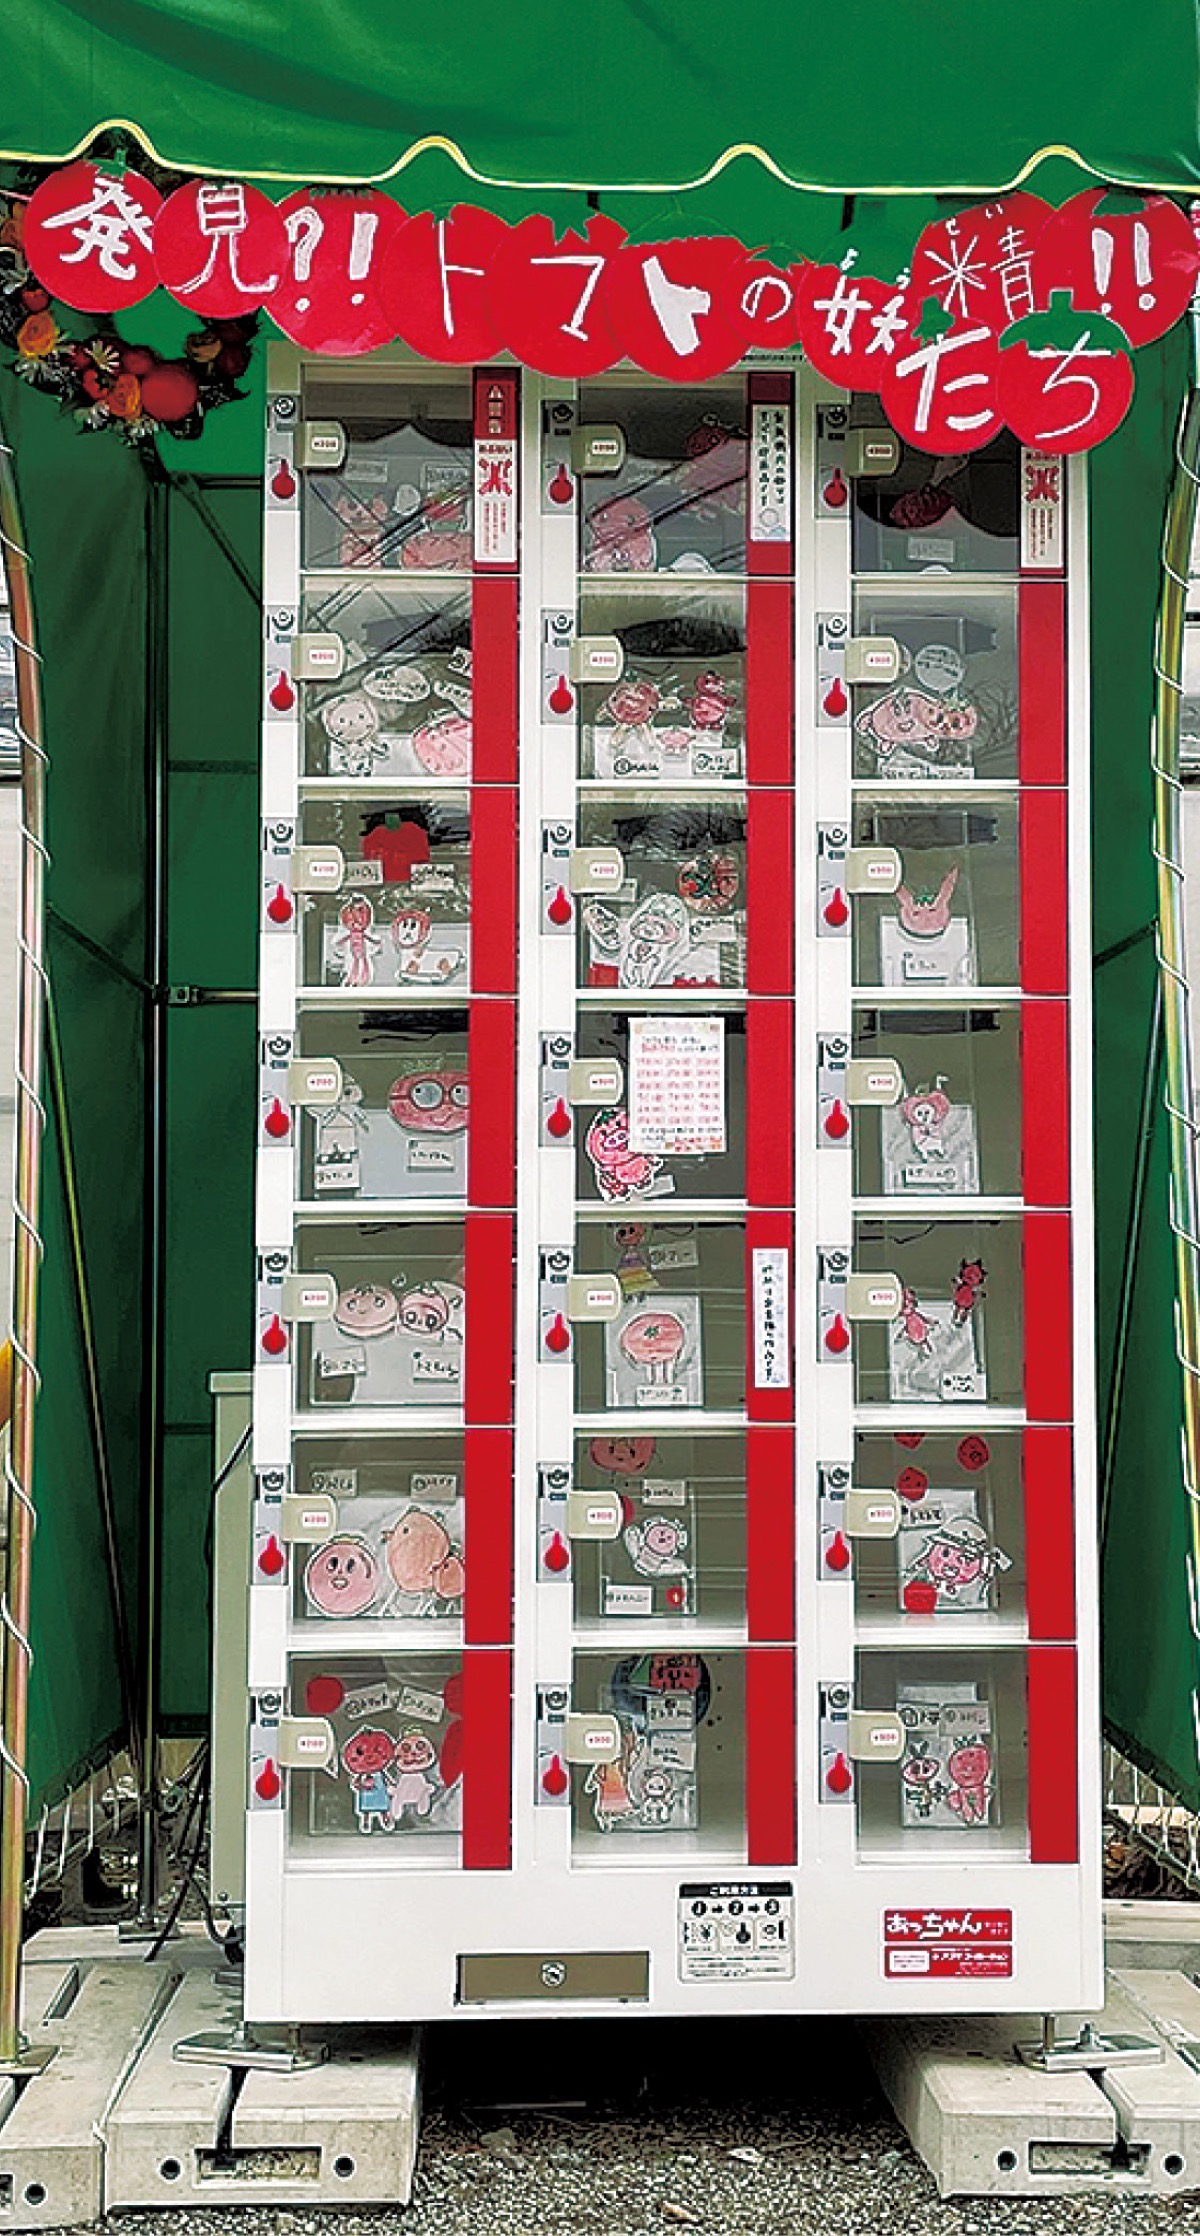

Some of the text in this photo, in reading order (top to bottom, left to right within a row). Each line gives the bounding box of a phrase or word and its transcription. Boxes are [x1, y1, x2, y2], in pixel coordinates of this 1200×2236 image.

[886, 1912, 982, 1940] あっちゃん
